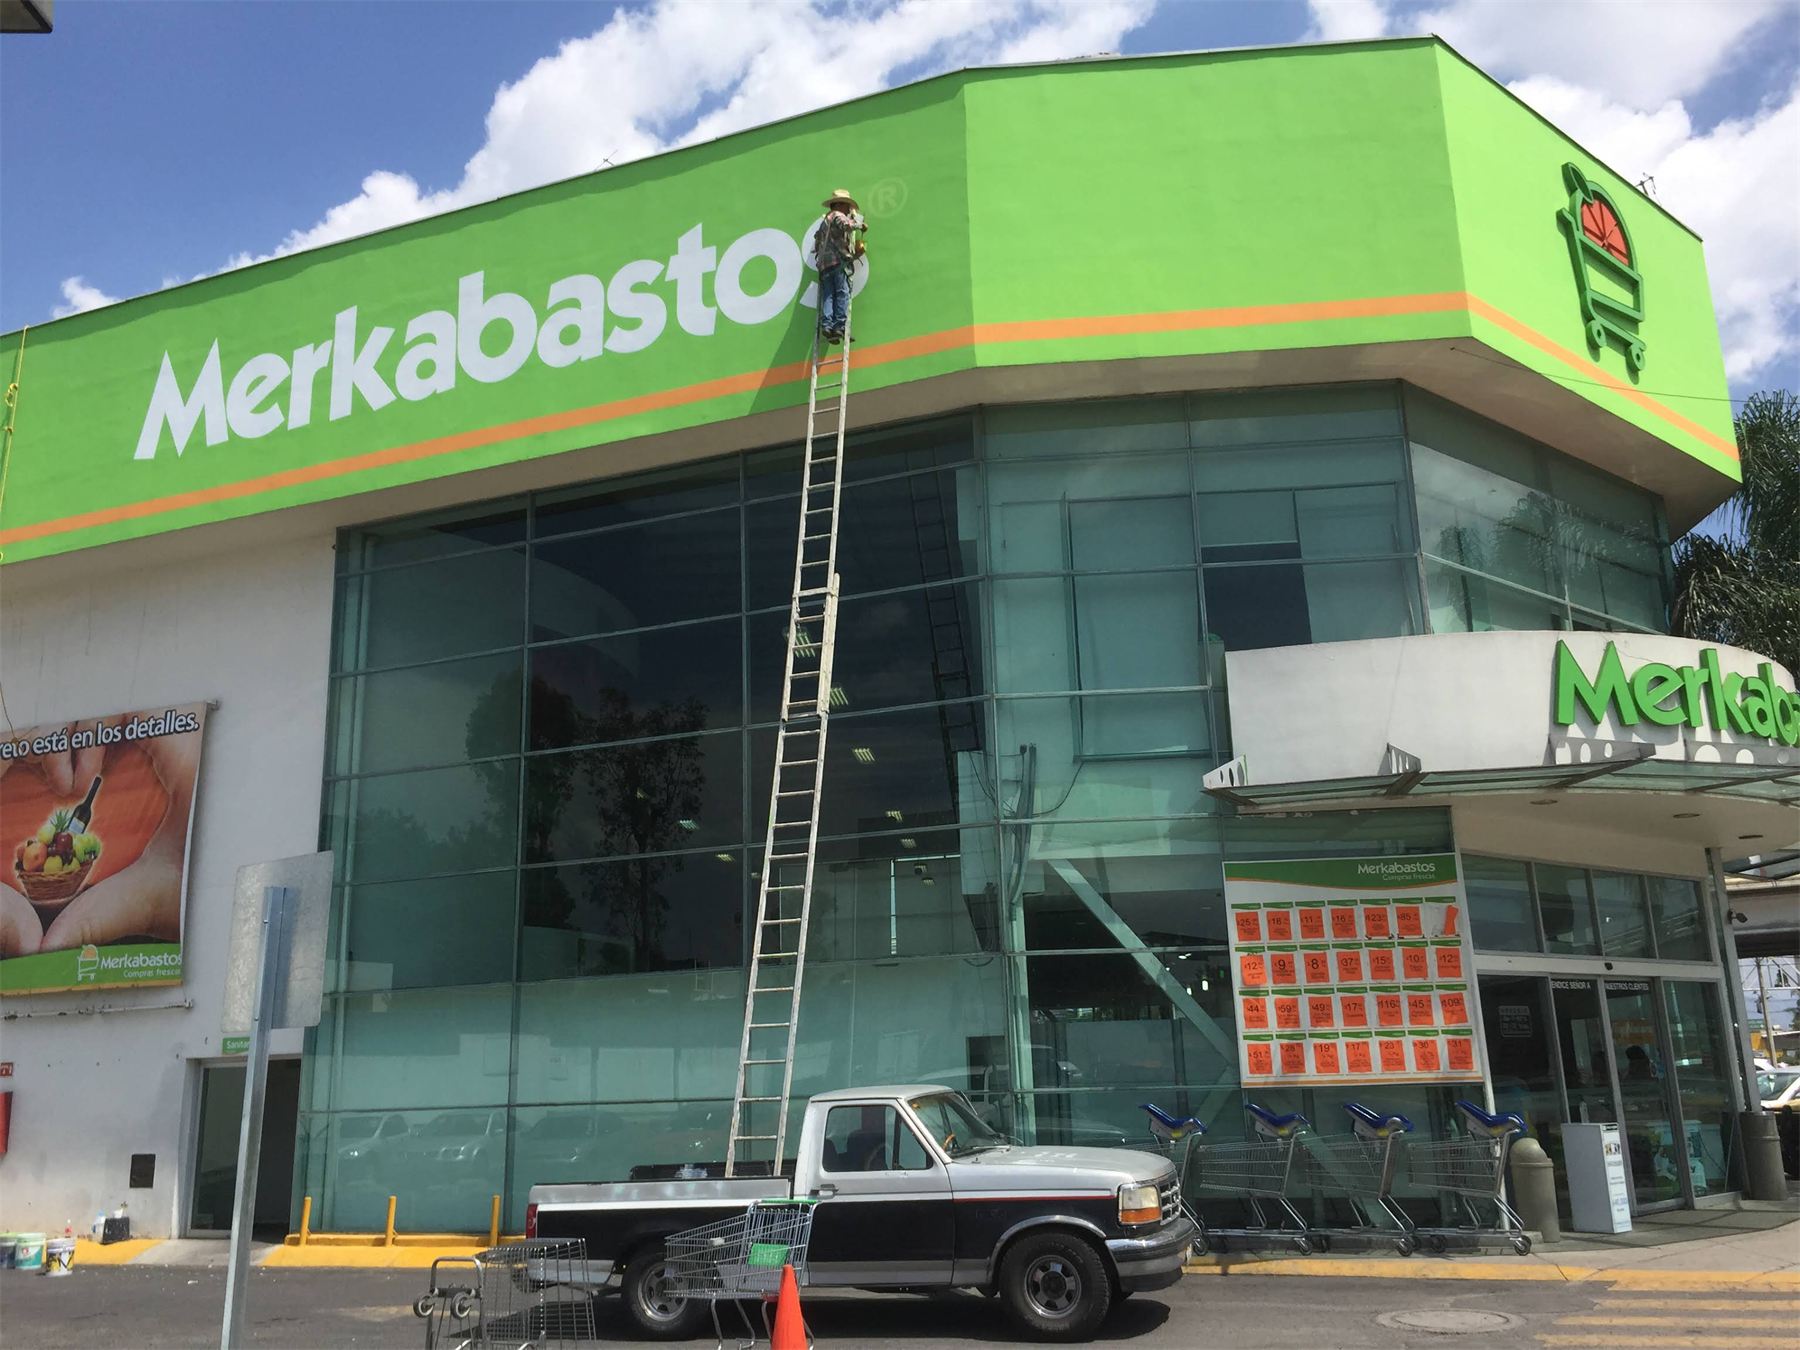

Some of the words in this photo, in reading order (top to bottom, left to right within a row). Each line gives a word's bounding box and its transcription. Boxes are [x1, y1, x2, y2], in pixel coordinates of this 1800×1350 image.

[32, 729, 69, 755] está
[71, 731, 94, 748] en
[97, 723, 123, 745] los
[125, 711, 200, 738] detalles.
[1357, 862, 1436, 875] Merkabastos
